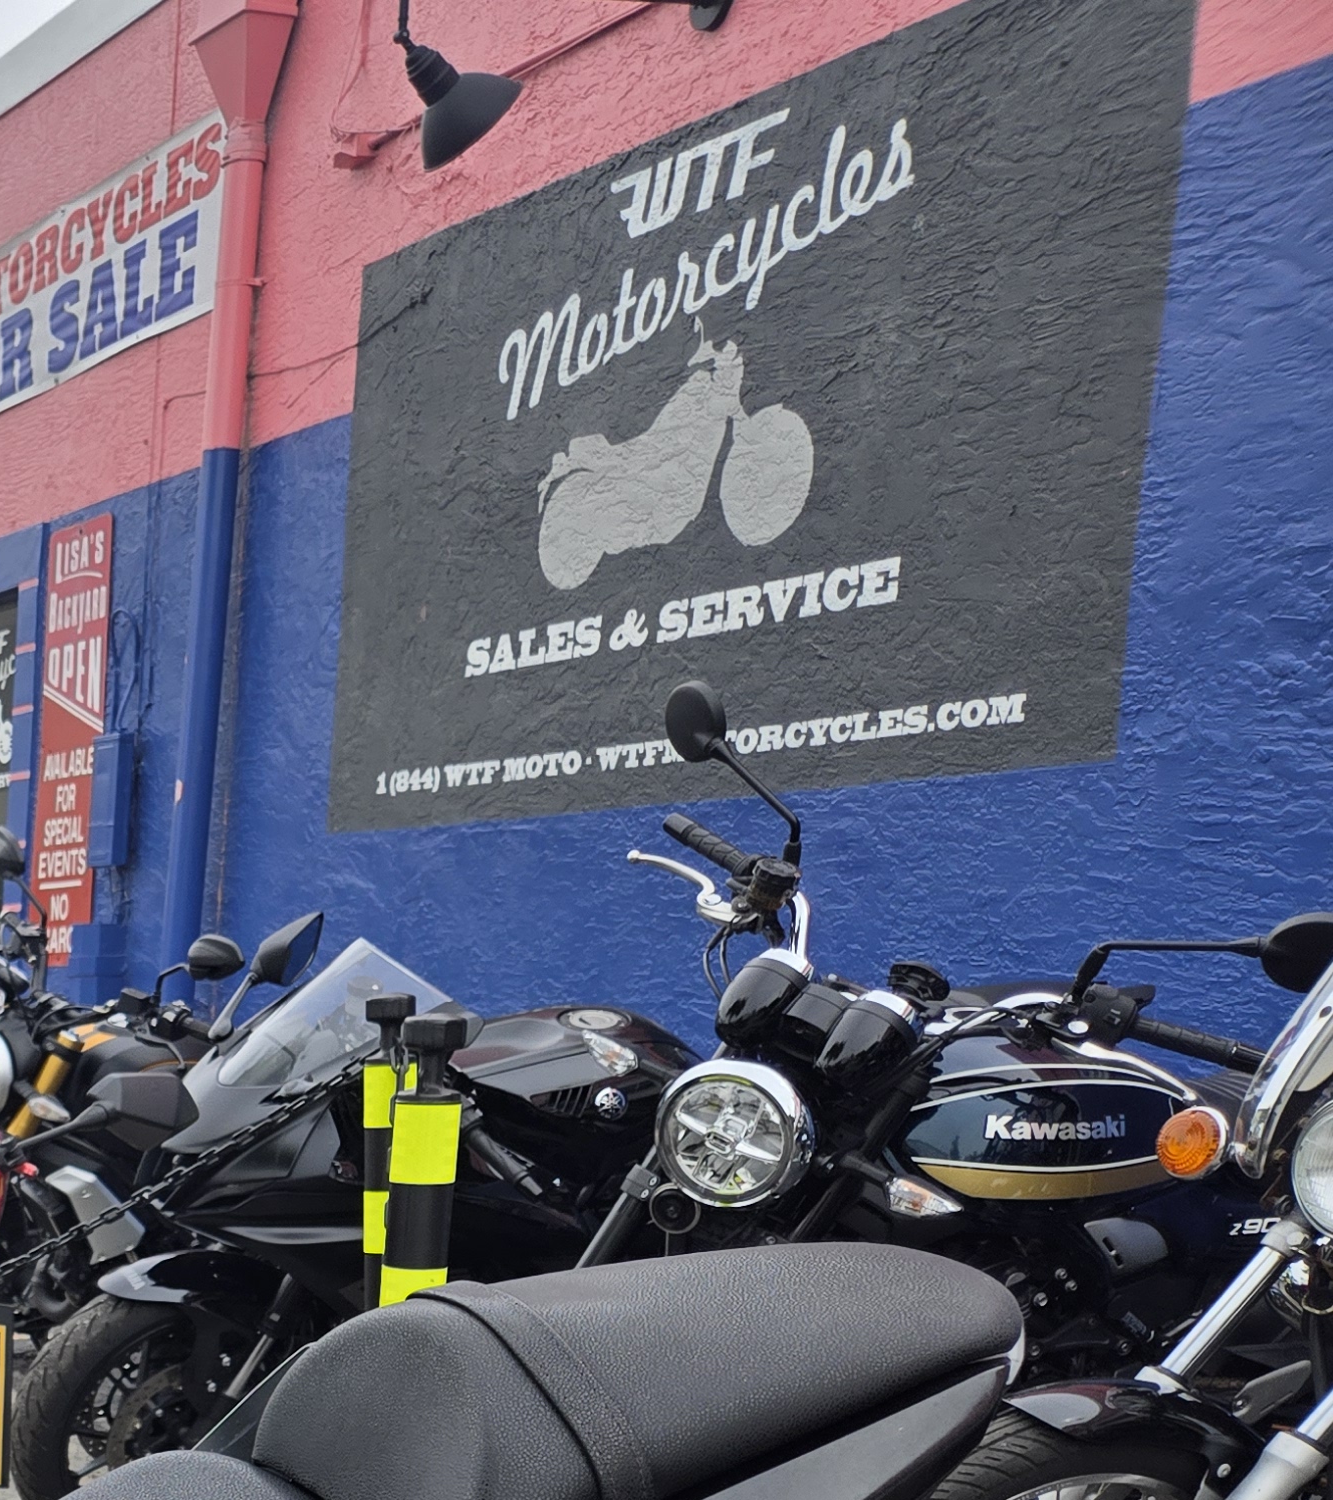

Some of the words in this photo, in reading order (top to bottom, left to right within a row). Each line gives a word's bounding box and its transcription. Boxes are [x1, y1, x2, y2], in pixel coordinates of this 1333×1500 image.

[611, 107, 790, 240] WTF
[47, 209, 199, 374] SALE
[498, 117, 915, 421] Motorcycles
[464, 608, 602, 678] SALES
[609, 606, 650, 651] &
[657, 555, 902, 645] SERVICE
[48, 635, 102, 714] OPEN
[375, 770, 387, 795] 1
[389, 766, 441, 797] (844)
[444, 760, 500, 788] WTF
[501, 750, 582, 783] MOTO
[596, 693, 1028, 772] WTFMORCYCLES.COM
[44, 815, 83, 847] SPECIAL
[55, 784, 77, 813] FOR
[38, 848, 86, 879] EVENTS
[51, 894, 69, 921] NO
[984, 1114, 1126, 1141] Kawasaki
